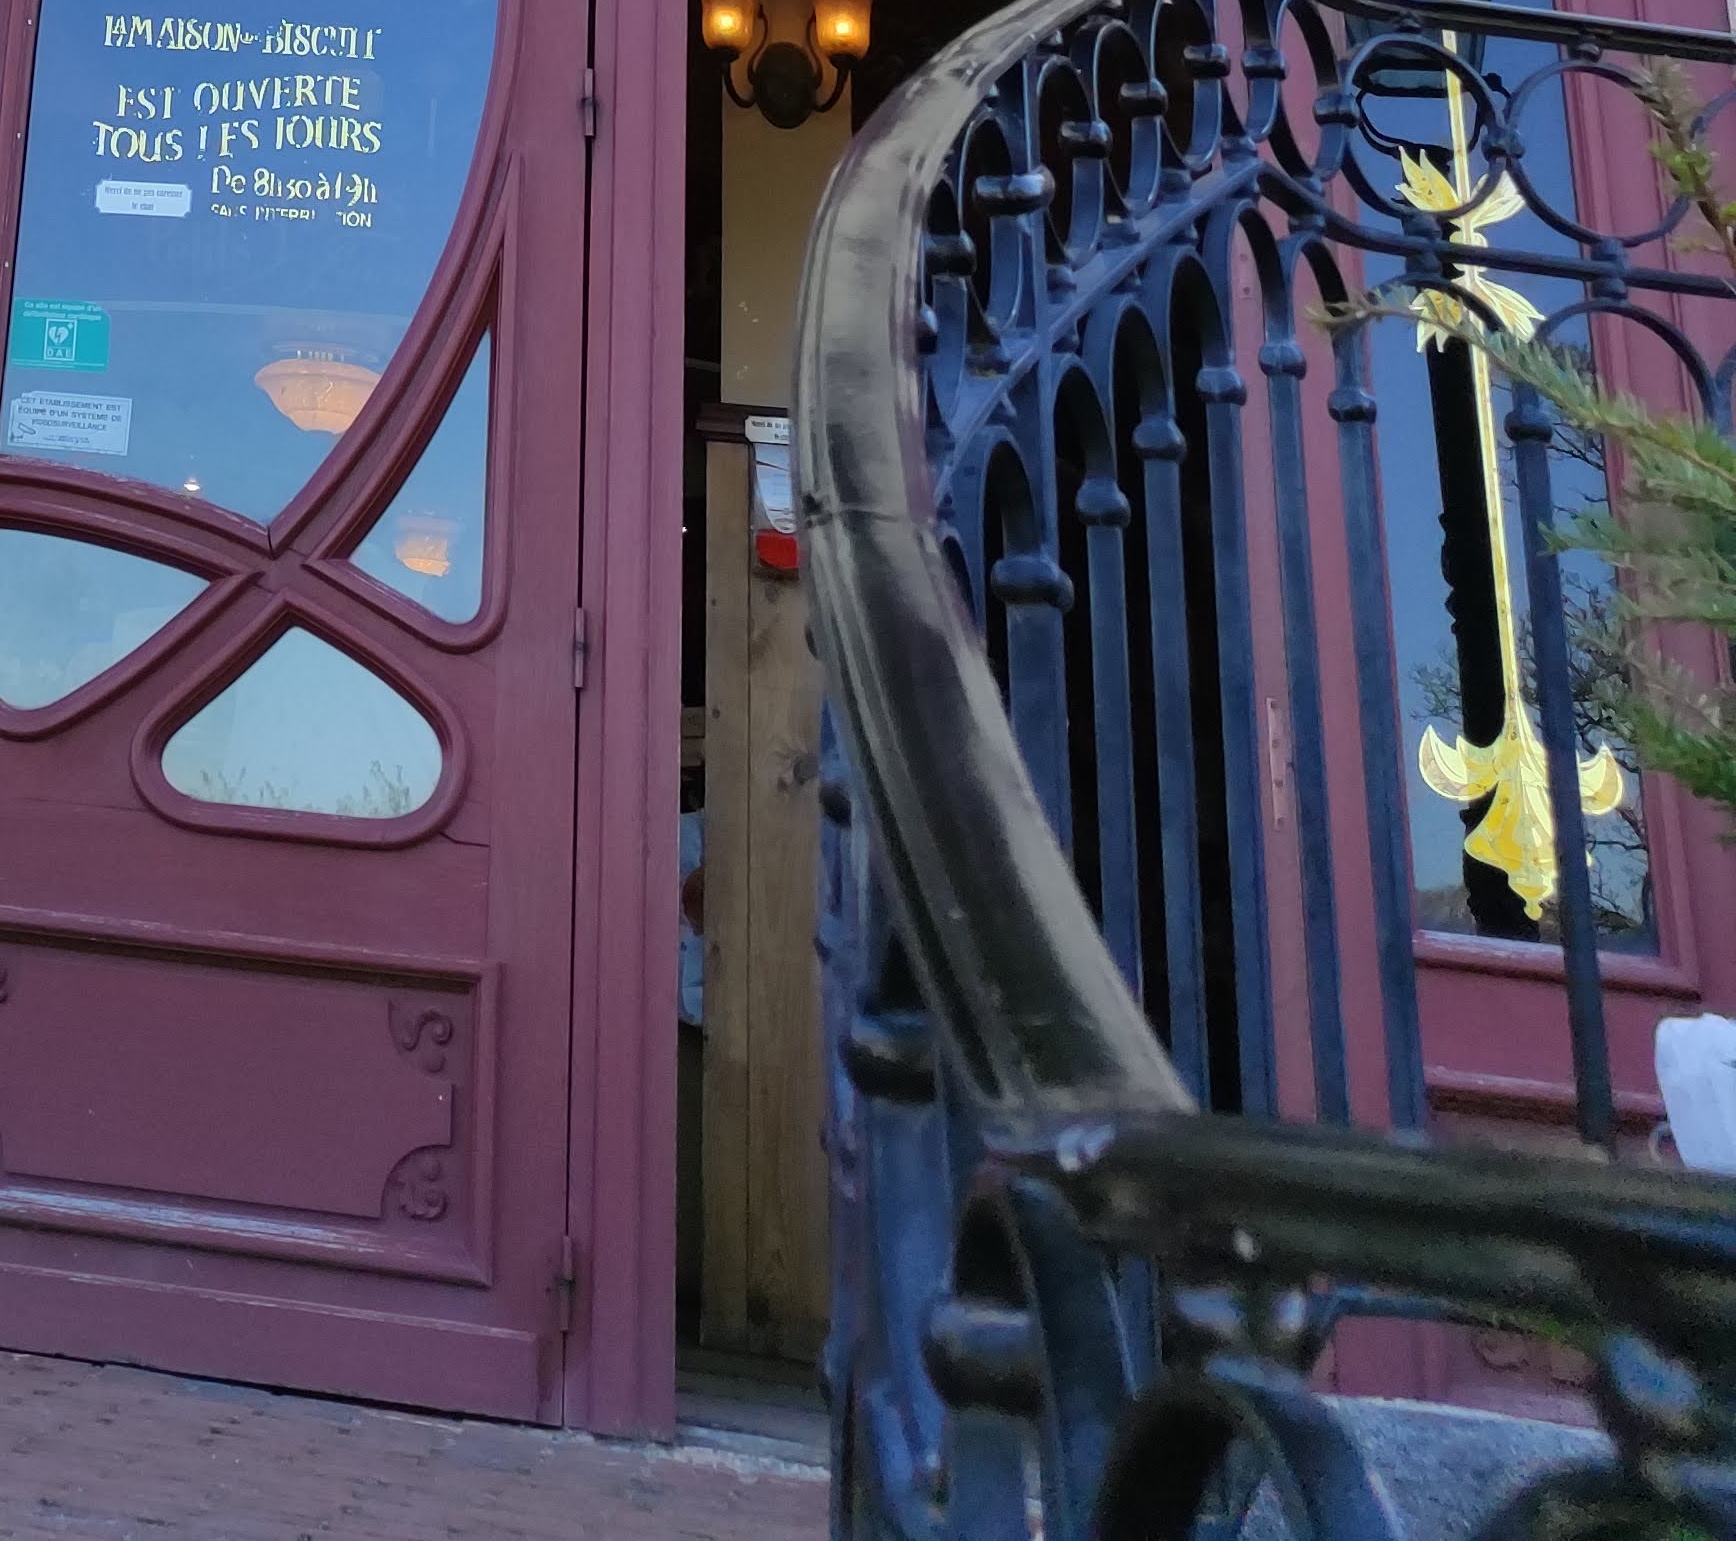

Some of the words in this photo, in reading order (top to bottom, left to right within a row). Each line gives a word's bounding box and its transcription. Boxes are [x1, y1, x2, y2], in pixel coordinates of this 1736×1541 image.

[126, 15, 240, 53] MAISON
[116, 84, 181, 120] EST
[193, 74, 361, 115] OUVERTE
[93, 120, 184, 163] TOUS
[274, 114, 383, 155] JOURS
[47, 348, 72, 358] DAE
